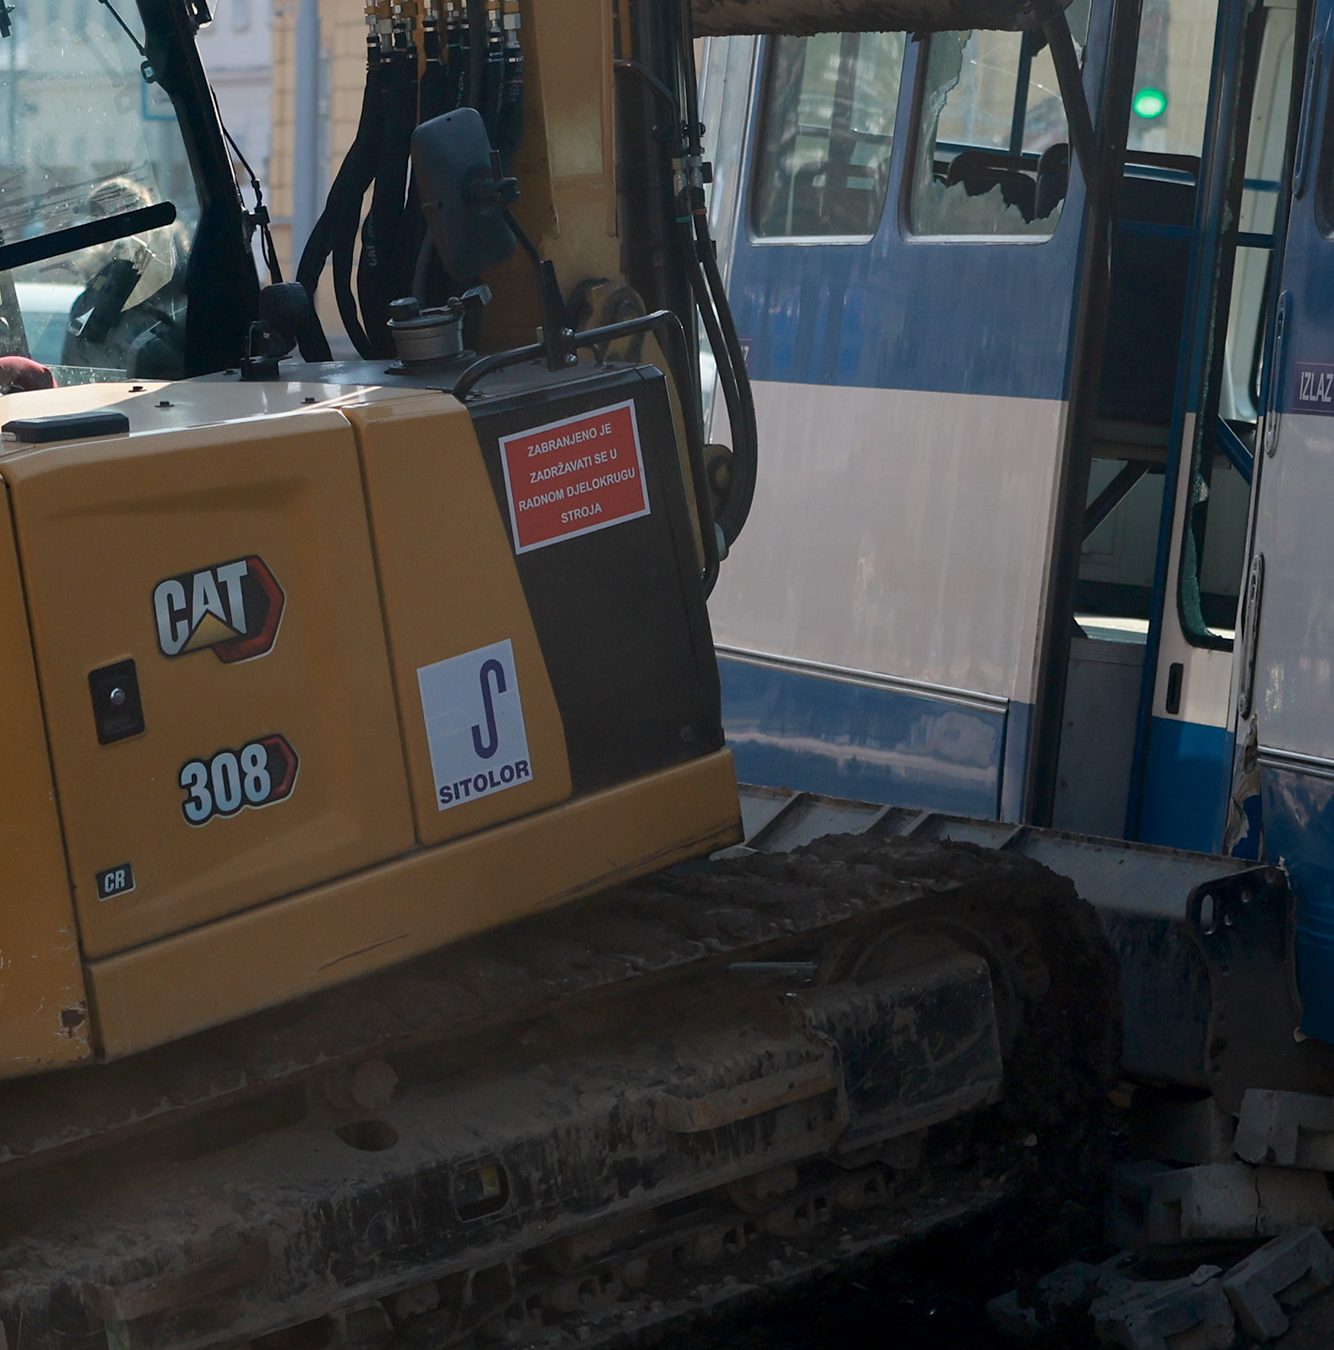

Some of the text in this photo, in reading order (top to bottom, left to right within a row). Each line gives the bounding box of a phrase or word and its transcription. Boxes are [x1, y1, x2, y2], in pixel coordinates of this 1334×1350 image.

[1299, 371, 1334, 403] IZLAZ
[527, 423, 612, 457] ZABRANJENO JE
[529, 448, 618, 484] ZADRŽAVATI SE U
[518, 467, 636, 512] RADNOM DJELOKRUGU
[561, 503, 603, 524] STROJA
[153, 560, 249, 656] CAT
[180, 743, 272, 822] 308
[438, 760, 531, 805] SITOLOR
[103, 868, 126, 894] CR
